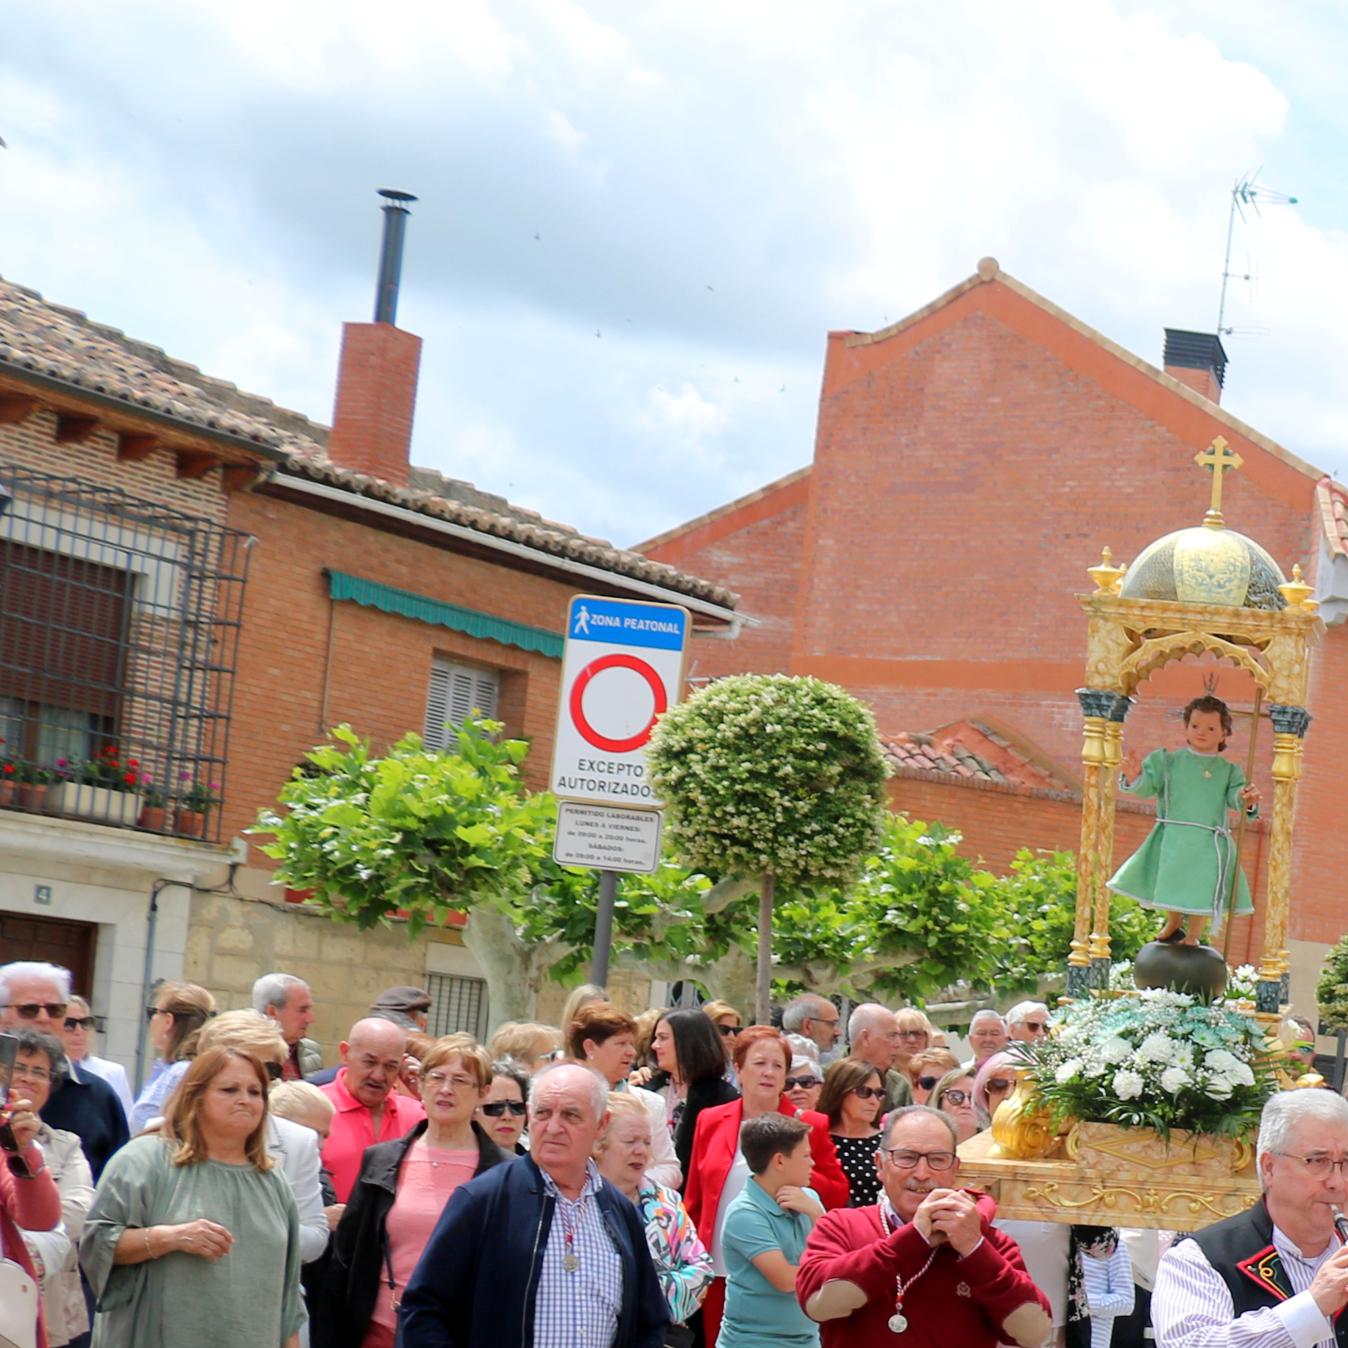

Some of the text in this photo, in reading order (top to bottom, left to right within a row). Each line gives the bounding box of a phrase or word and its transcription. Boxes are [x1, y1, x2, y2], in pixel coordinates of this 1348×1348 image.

[590, 613, 681, 635] ZONA PEATONAL
[577, 758, 644, 777] EXCEPTO
[557, 776, 653, 798] AUTORIZADO
[565, 808, 654, 823] PERMITIDO LABORABLES
[575, 820, 599, 828] LUNES
[608, 823, 641, 832] VIERNES:
